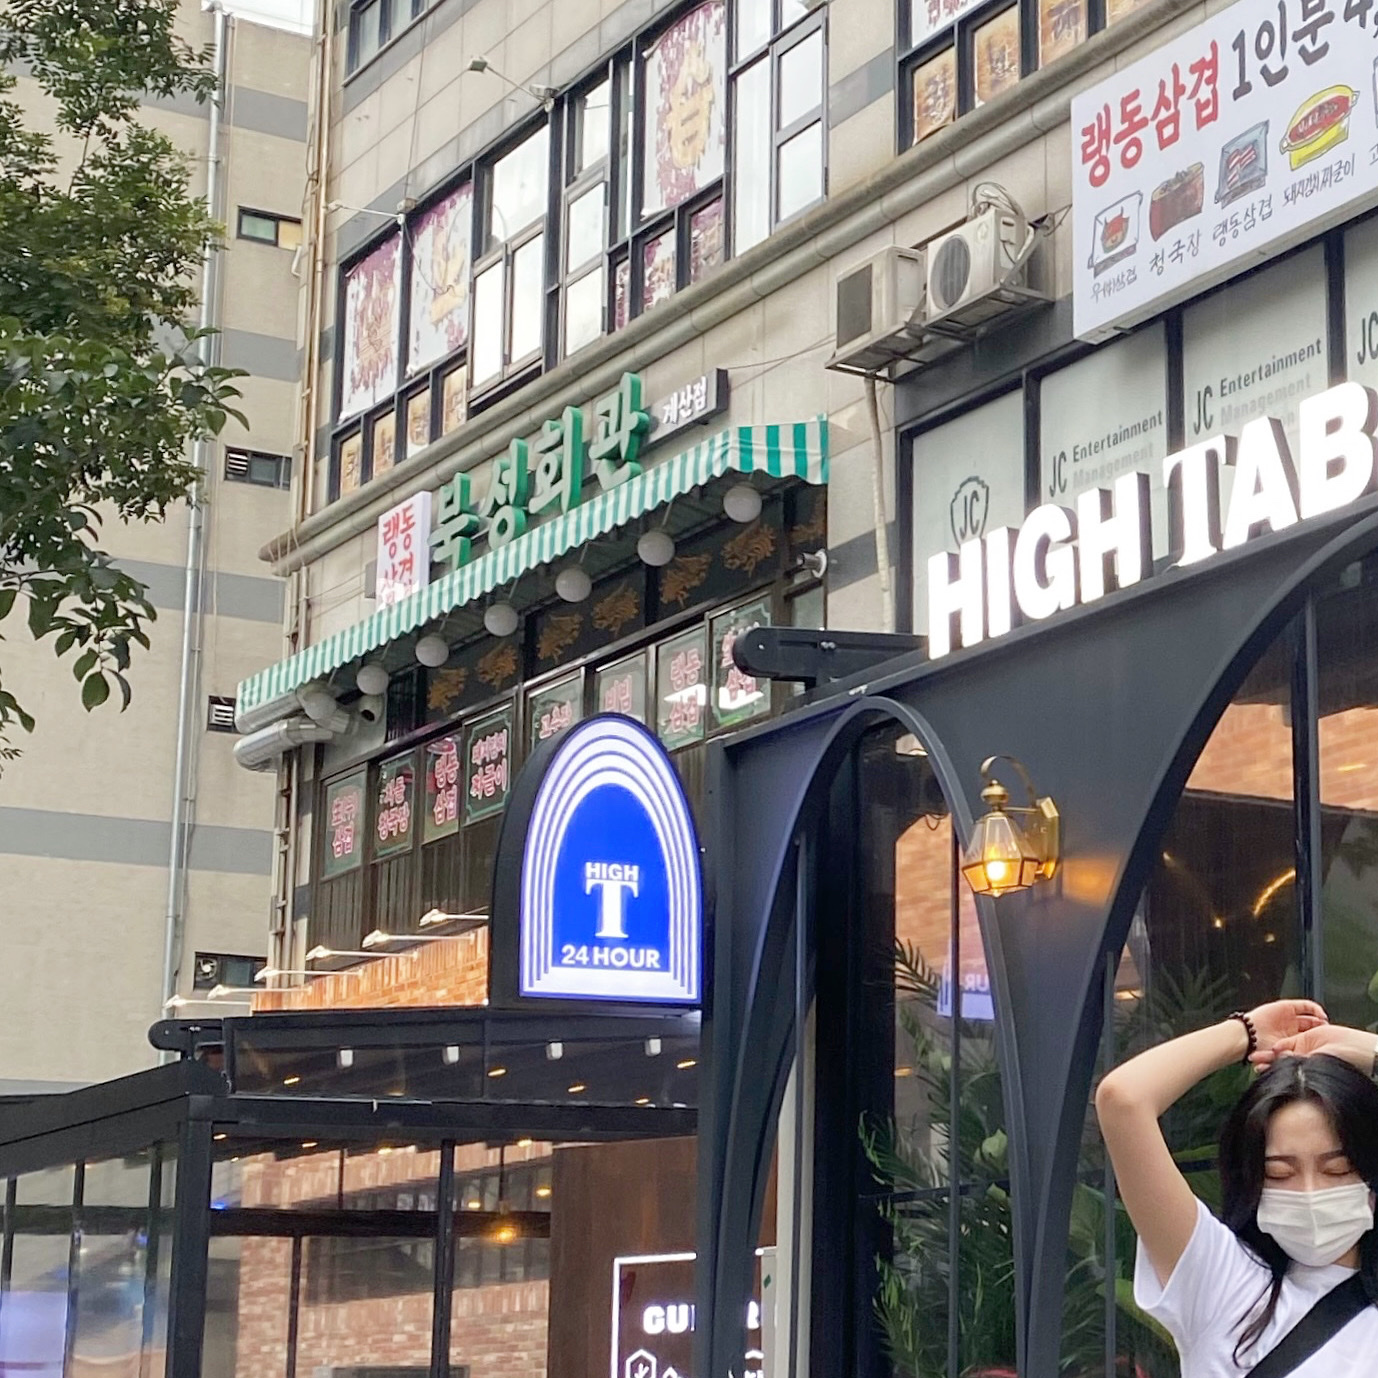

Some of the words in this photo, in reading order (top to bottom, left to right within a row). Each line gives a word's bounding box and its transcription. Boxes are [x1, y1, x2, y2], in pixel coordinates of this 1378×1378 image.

[1080, 38, 1221, 188] 랭동삼겹
[1231, 0, 1336, 102] 1인분
[1211, 194, 1273, 247] 랭동삼겹
[1149, 229, 1202, 276] 청국장
[1193, 384, 1214, 436] JC
[1220, 337, 1322, 398] Entertainment
[427, 371, 650, 571] 북성회관
[661, 375, 708, 425] 계산점
[1050, 451, 1067, 498] JC
[1073, 409, 1163, 464] Entertainment
[382, 503, 417, 559] 랭동
[959, 489, 980, 541] JC
[928, 470, 1144, 661] HIGH
[584, 861, 640, 883] HIGH
[584, 879, 640, 939] T
[560, 944, 590, 967] 24
[592, 946, 661, 969] HOUR
